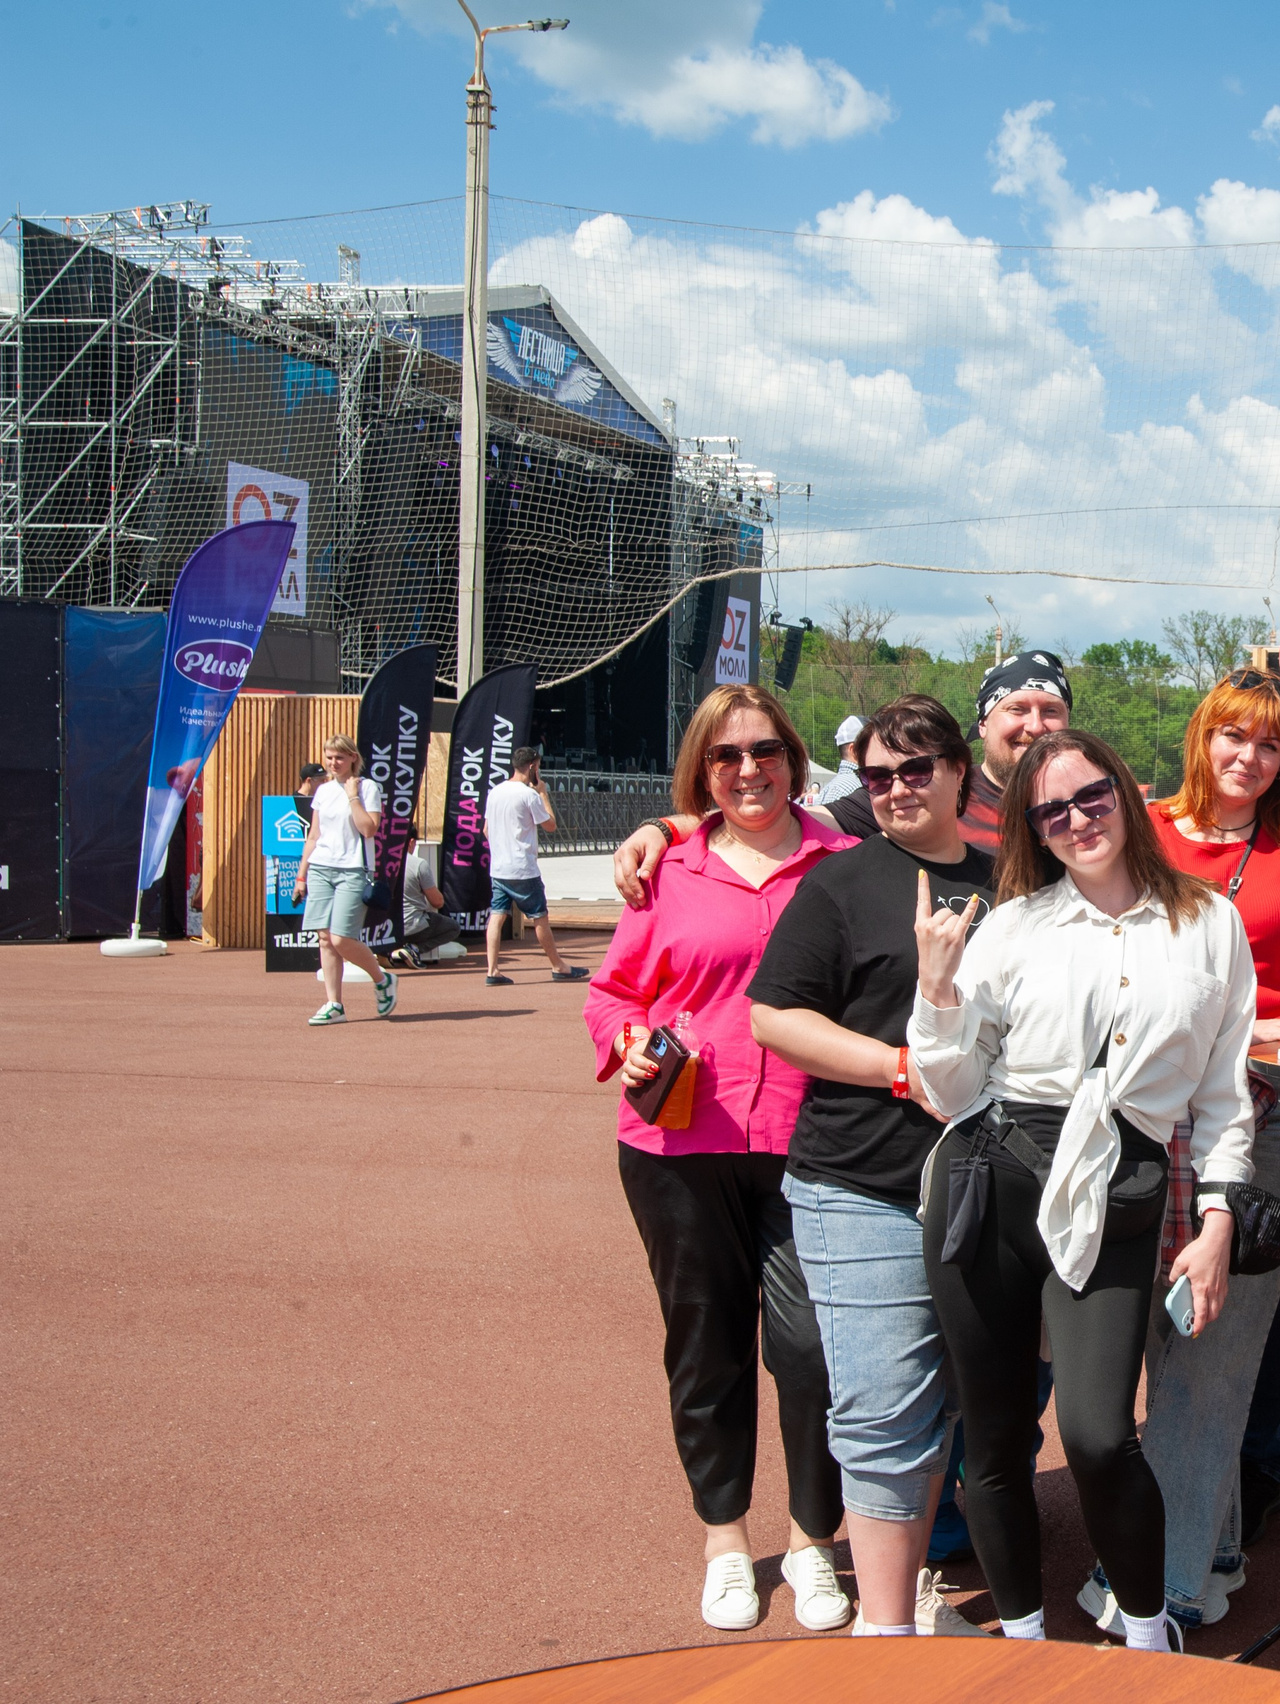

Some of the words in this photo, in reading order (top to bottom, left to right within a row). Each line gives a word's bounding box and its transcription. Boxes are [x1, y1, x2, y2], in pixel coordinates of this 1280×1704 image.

[517, 325, 566, 376] ЛЕСТНИЦА
[721, 606, 747, 652] OZ
[183, 651, 249, 679] Plush
[390, 704, 418, 835] ПОКУПКУ
[453, 746, 485, 867] ПОДАРОК
[273, 930, 319, 948] TELE2
[360, 919, 397, 947] ELE2
